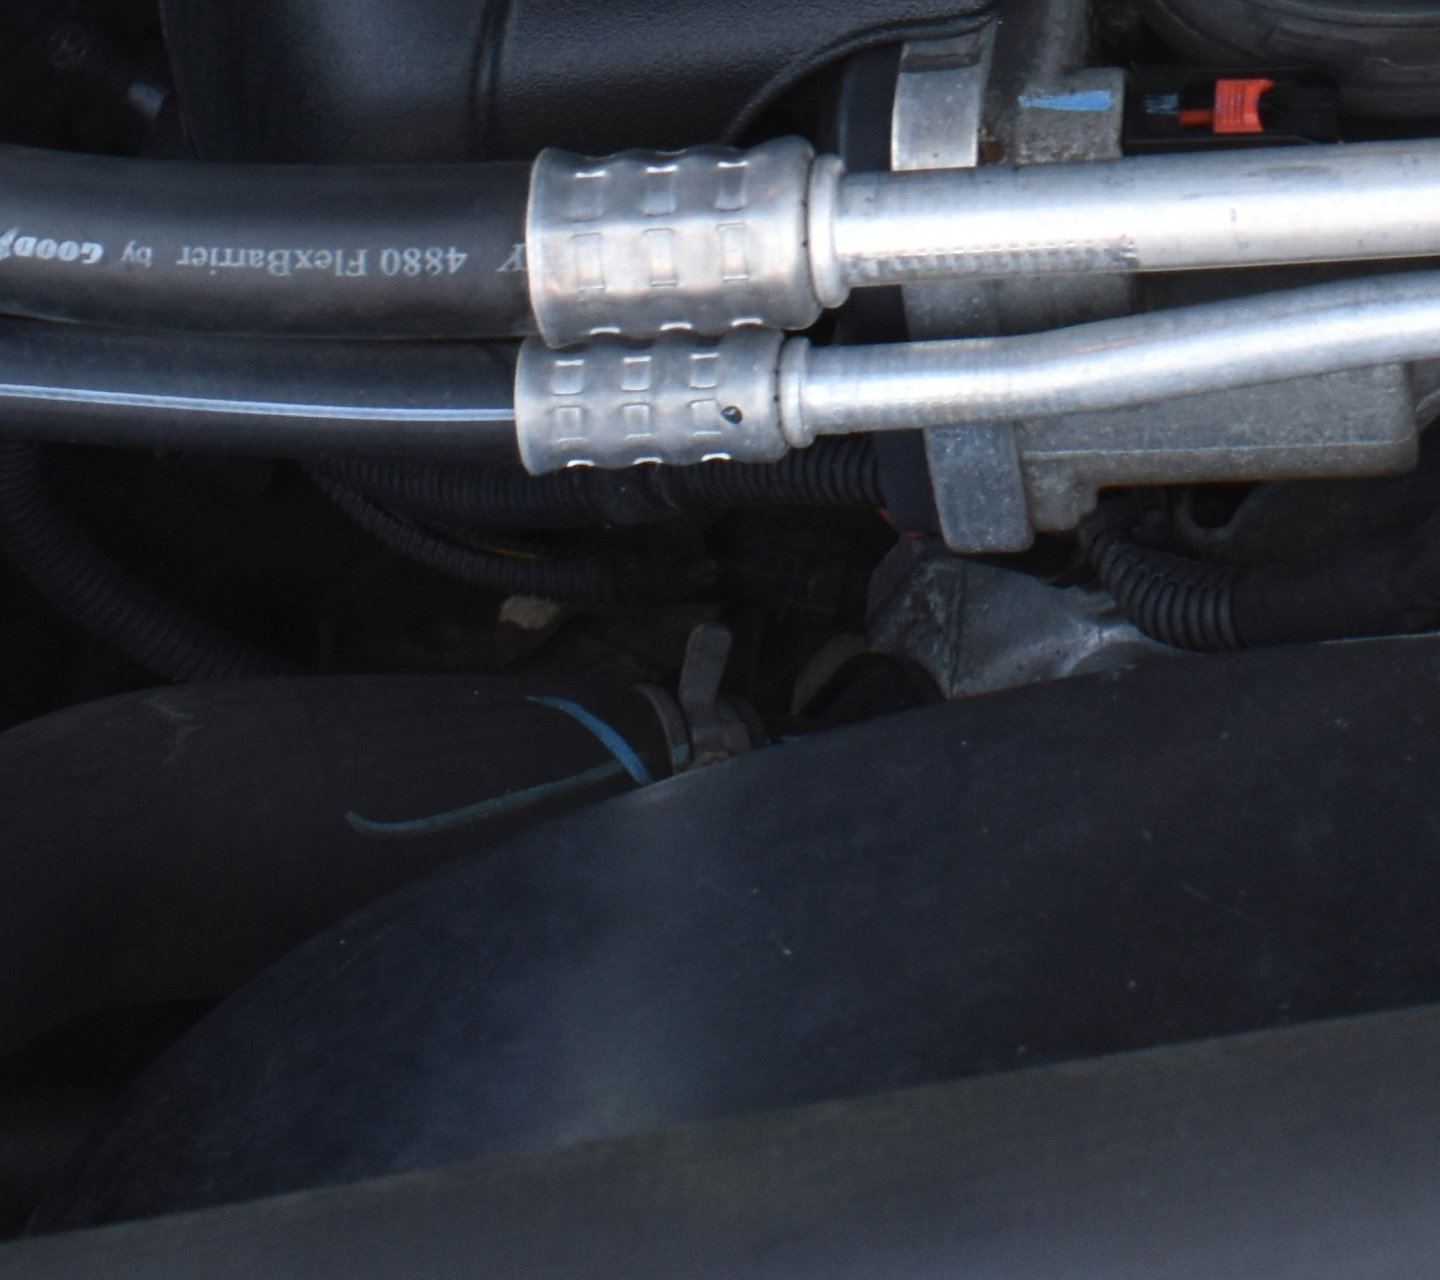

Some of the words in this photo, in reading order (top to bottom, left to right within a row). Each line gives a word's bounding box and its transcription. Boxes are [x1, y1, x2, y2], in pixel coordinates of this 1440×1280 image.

[120, 240, 152, 268] by
[175, 243, 369, 277] FlexBarrier
[379, 245, 468, 277] 4880
